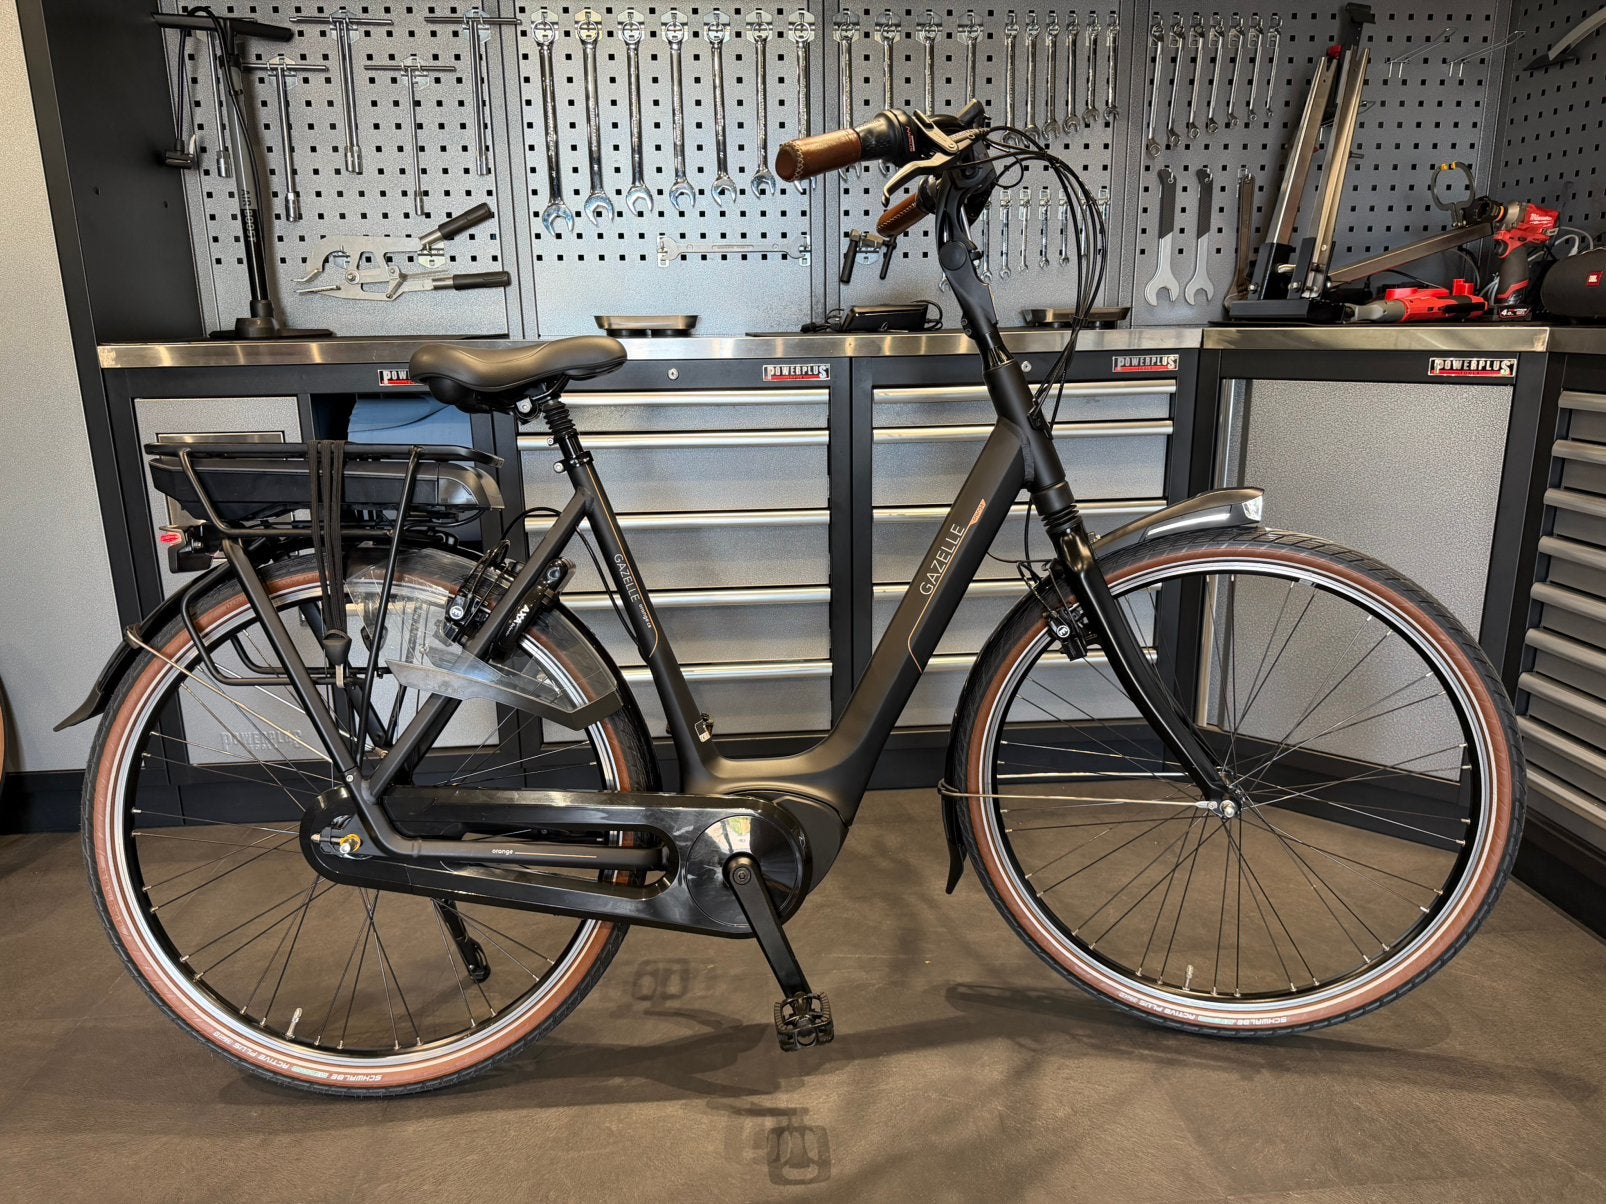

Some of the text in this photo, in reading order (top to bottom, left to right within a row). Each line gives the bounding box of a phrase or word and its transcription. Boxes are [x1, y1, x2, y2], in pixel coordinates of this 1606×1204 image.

[244, 209, 257, 243] BOOST
[1117, 355, 1176, 372] POWERPLUS
[1434, 360, 1511, 376] POWERPLUS
[766, 365, 828, 380] POWERPLUS
[919, 523, 965, 595] GAZELLE
[613, 553, 640, 603] GAZELLE
[513, 604, 530, 624] AXA
[638, 603, 650, 623] orange
[1236, 1016, 1287, 1026] SCHWALBE
[232, 1042, 258, 1058] PLUS
[257, 1054, 291, 1069] ACTIVE
[330, 1072, 383, 1082] SCHWALBE
